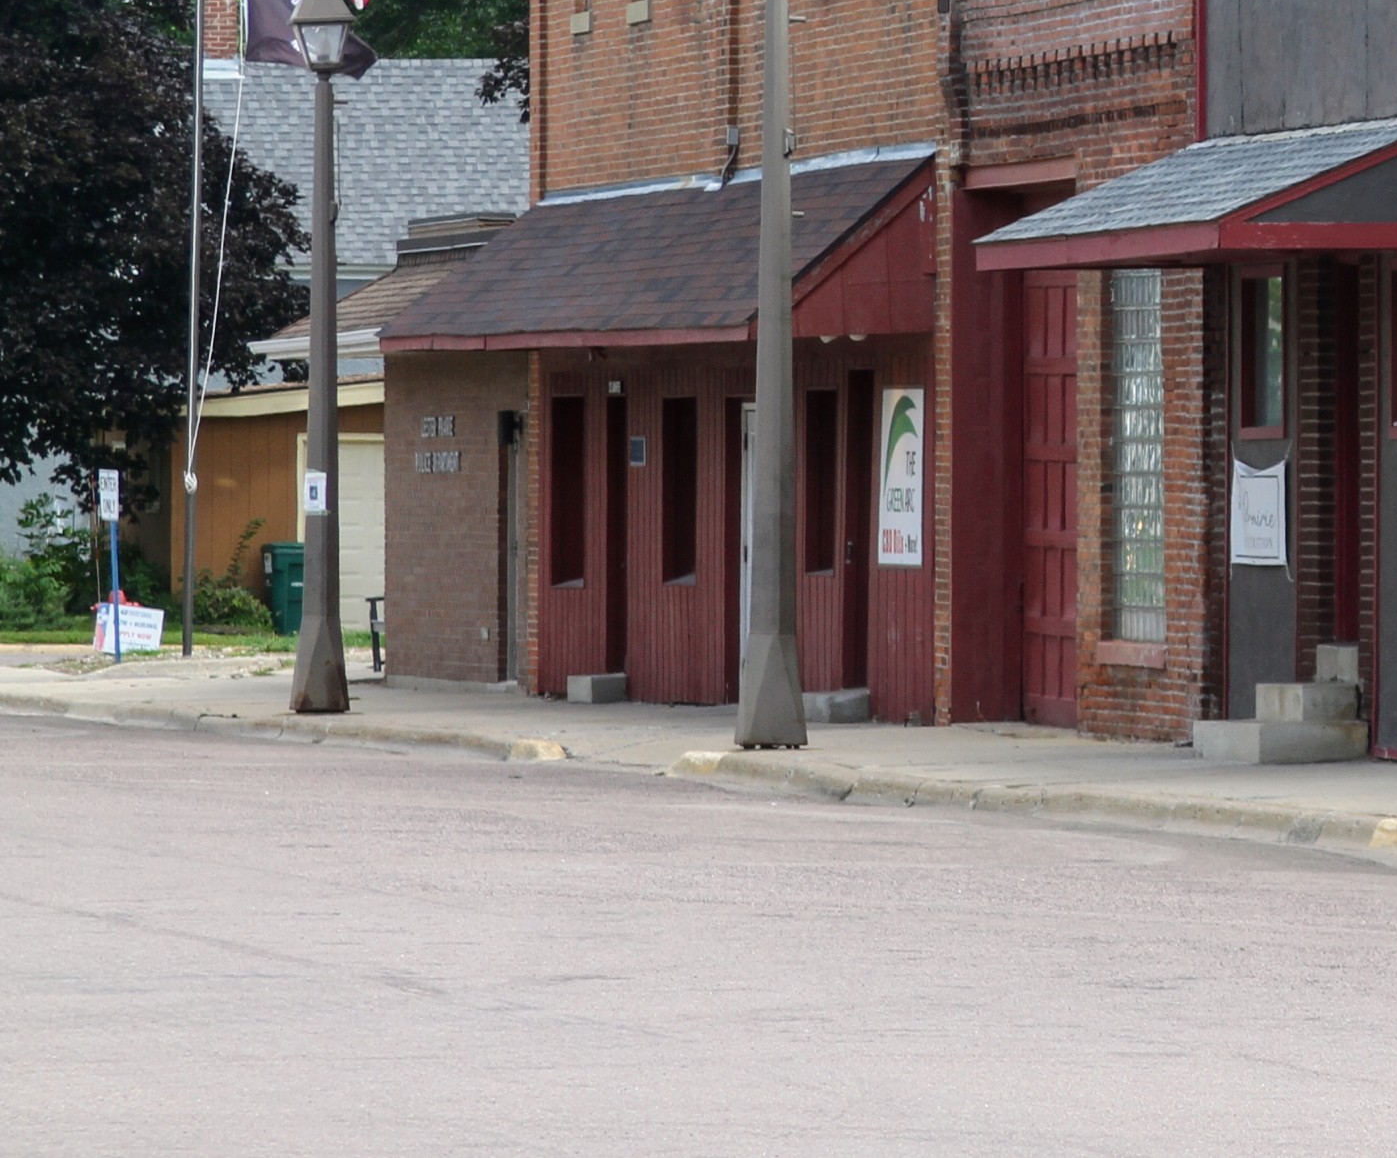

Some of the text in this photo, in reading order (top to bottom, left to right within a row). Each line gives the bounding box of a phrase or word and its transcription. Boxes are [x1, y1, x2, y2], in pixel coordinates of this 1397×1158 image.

[906, 451, 916, 476] THE
[101, 477, 117, 493] ENTER
[103, 498, 116, 514] ONLY
